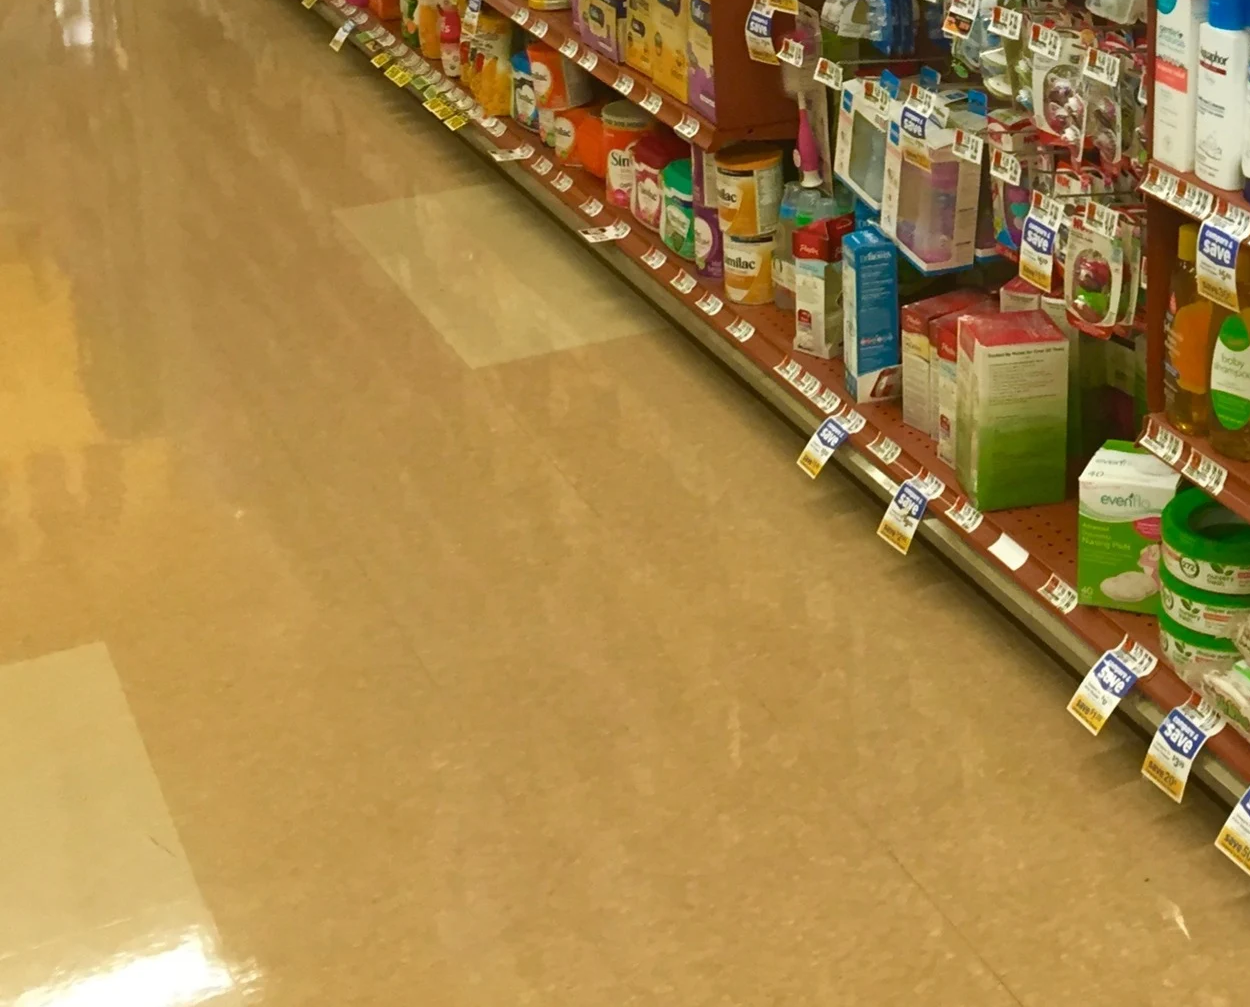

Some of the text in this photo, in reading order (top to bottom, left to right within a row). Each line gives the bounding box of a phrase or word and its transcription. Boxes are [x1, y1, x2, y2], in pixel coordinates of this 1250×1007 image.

[1203, 239, 1231, 264] save
[1222, 353, 1244, 368] baby
[1101, 493, 1151, 510] evenflo
[1098, 666, 1125, 694] save
[1164, 723, 1193, 754] save
[1149, 761, 1164, 777] save
[1223, 834, 1242, 852] save
